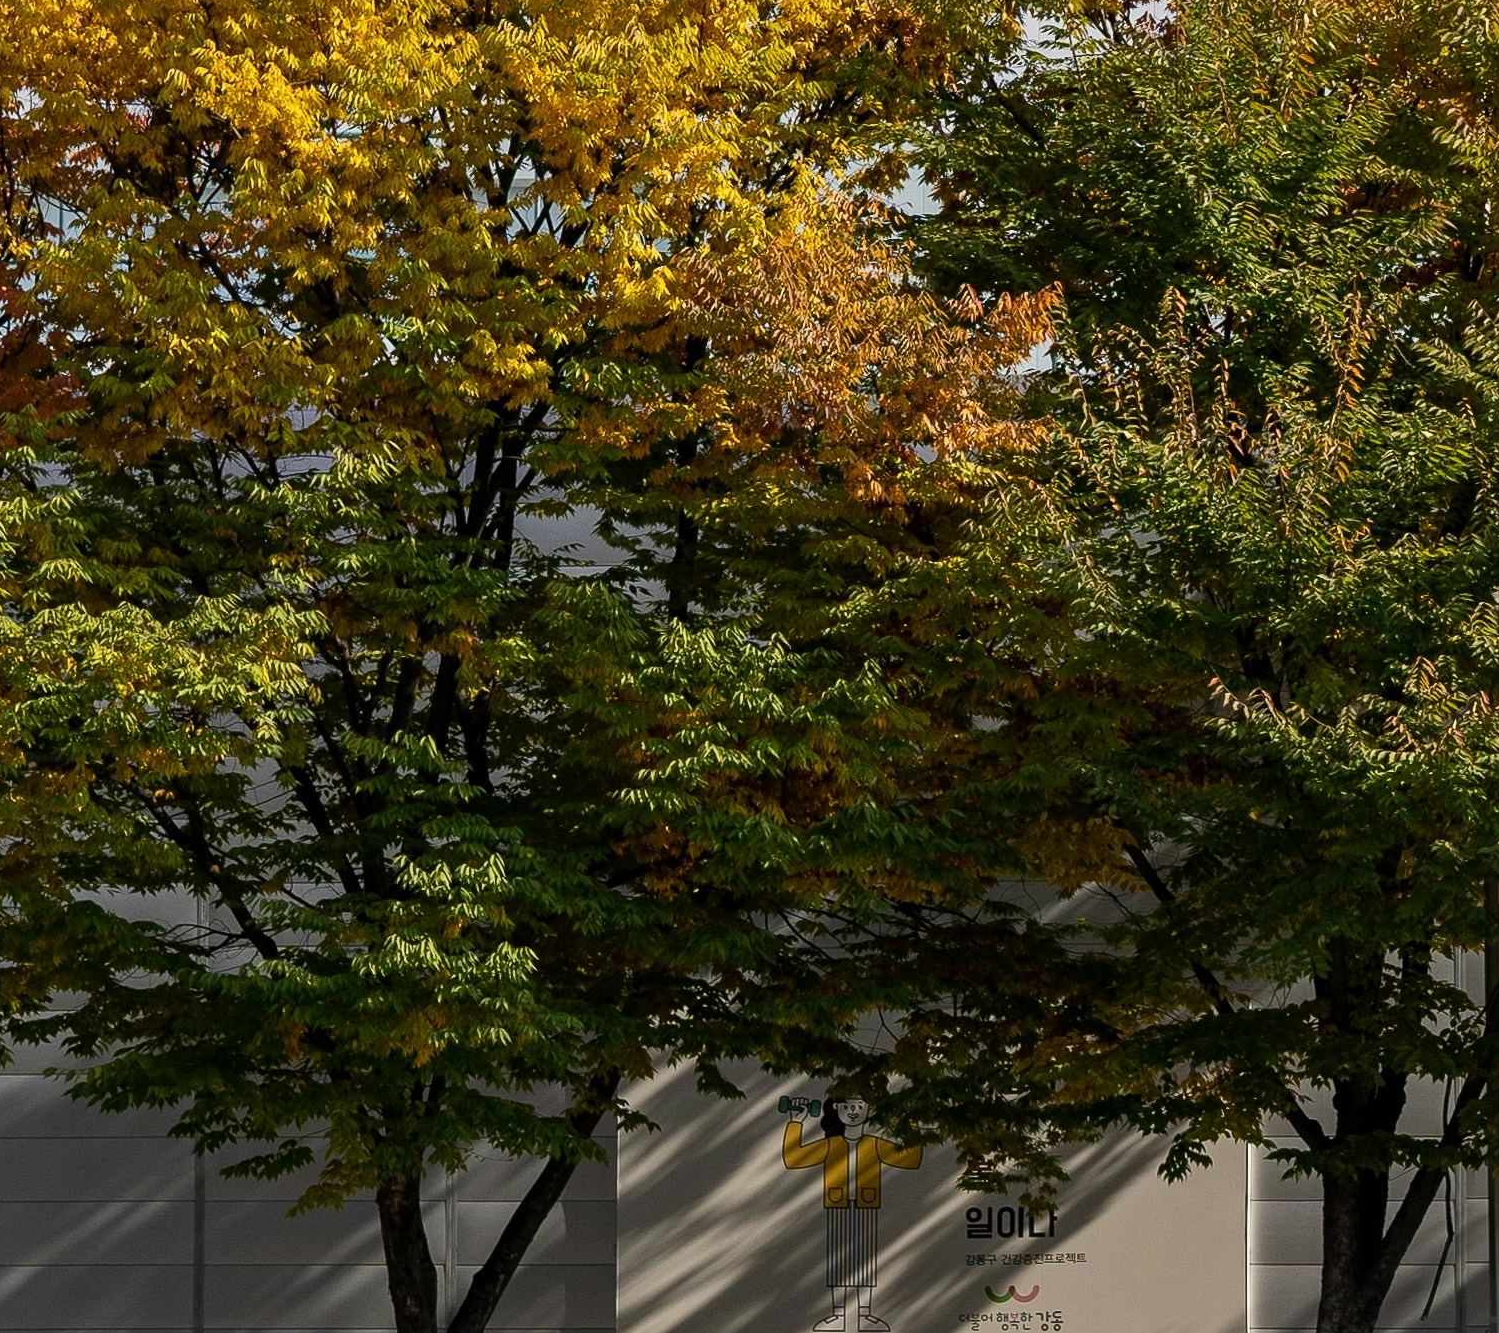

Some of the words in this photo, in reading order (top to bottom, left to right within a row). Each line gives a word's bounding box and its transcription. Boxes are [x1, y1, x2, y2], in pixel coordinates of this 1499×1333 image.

[966, 1254, 997, 1266] 강동구
[1002, 1253, 1087, 1266] 건강증진프로젝트
[958, 1312, 993, 1331] 더불어
[996, 1311, 1033, 1331] 행복한
[1035, 1310, 1063, 1332] 강동
